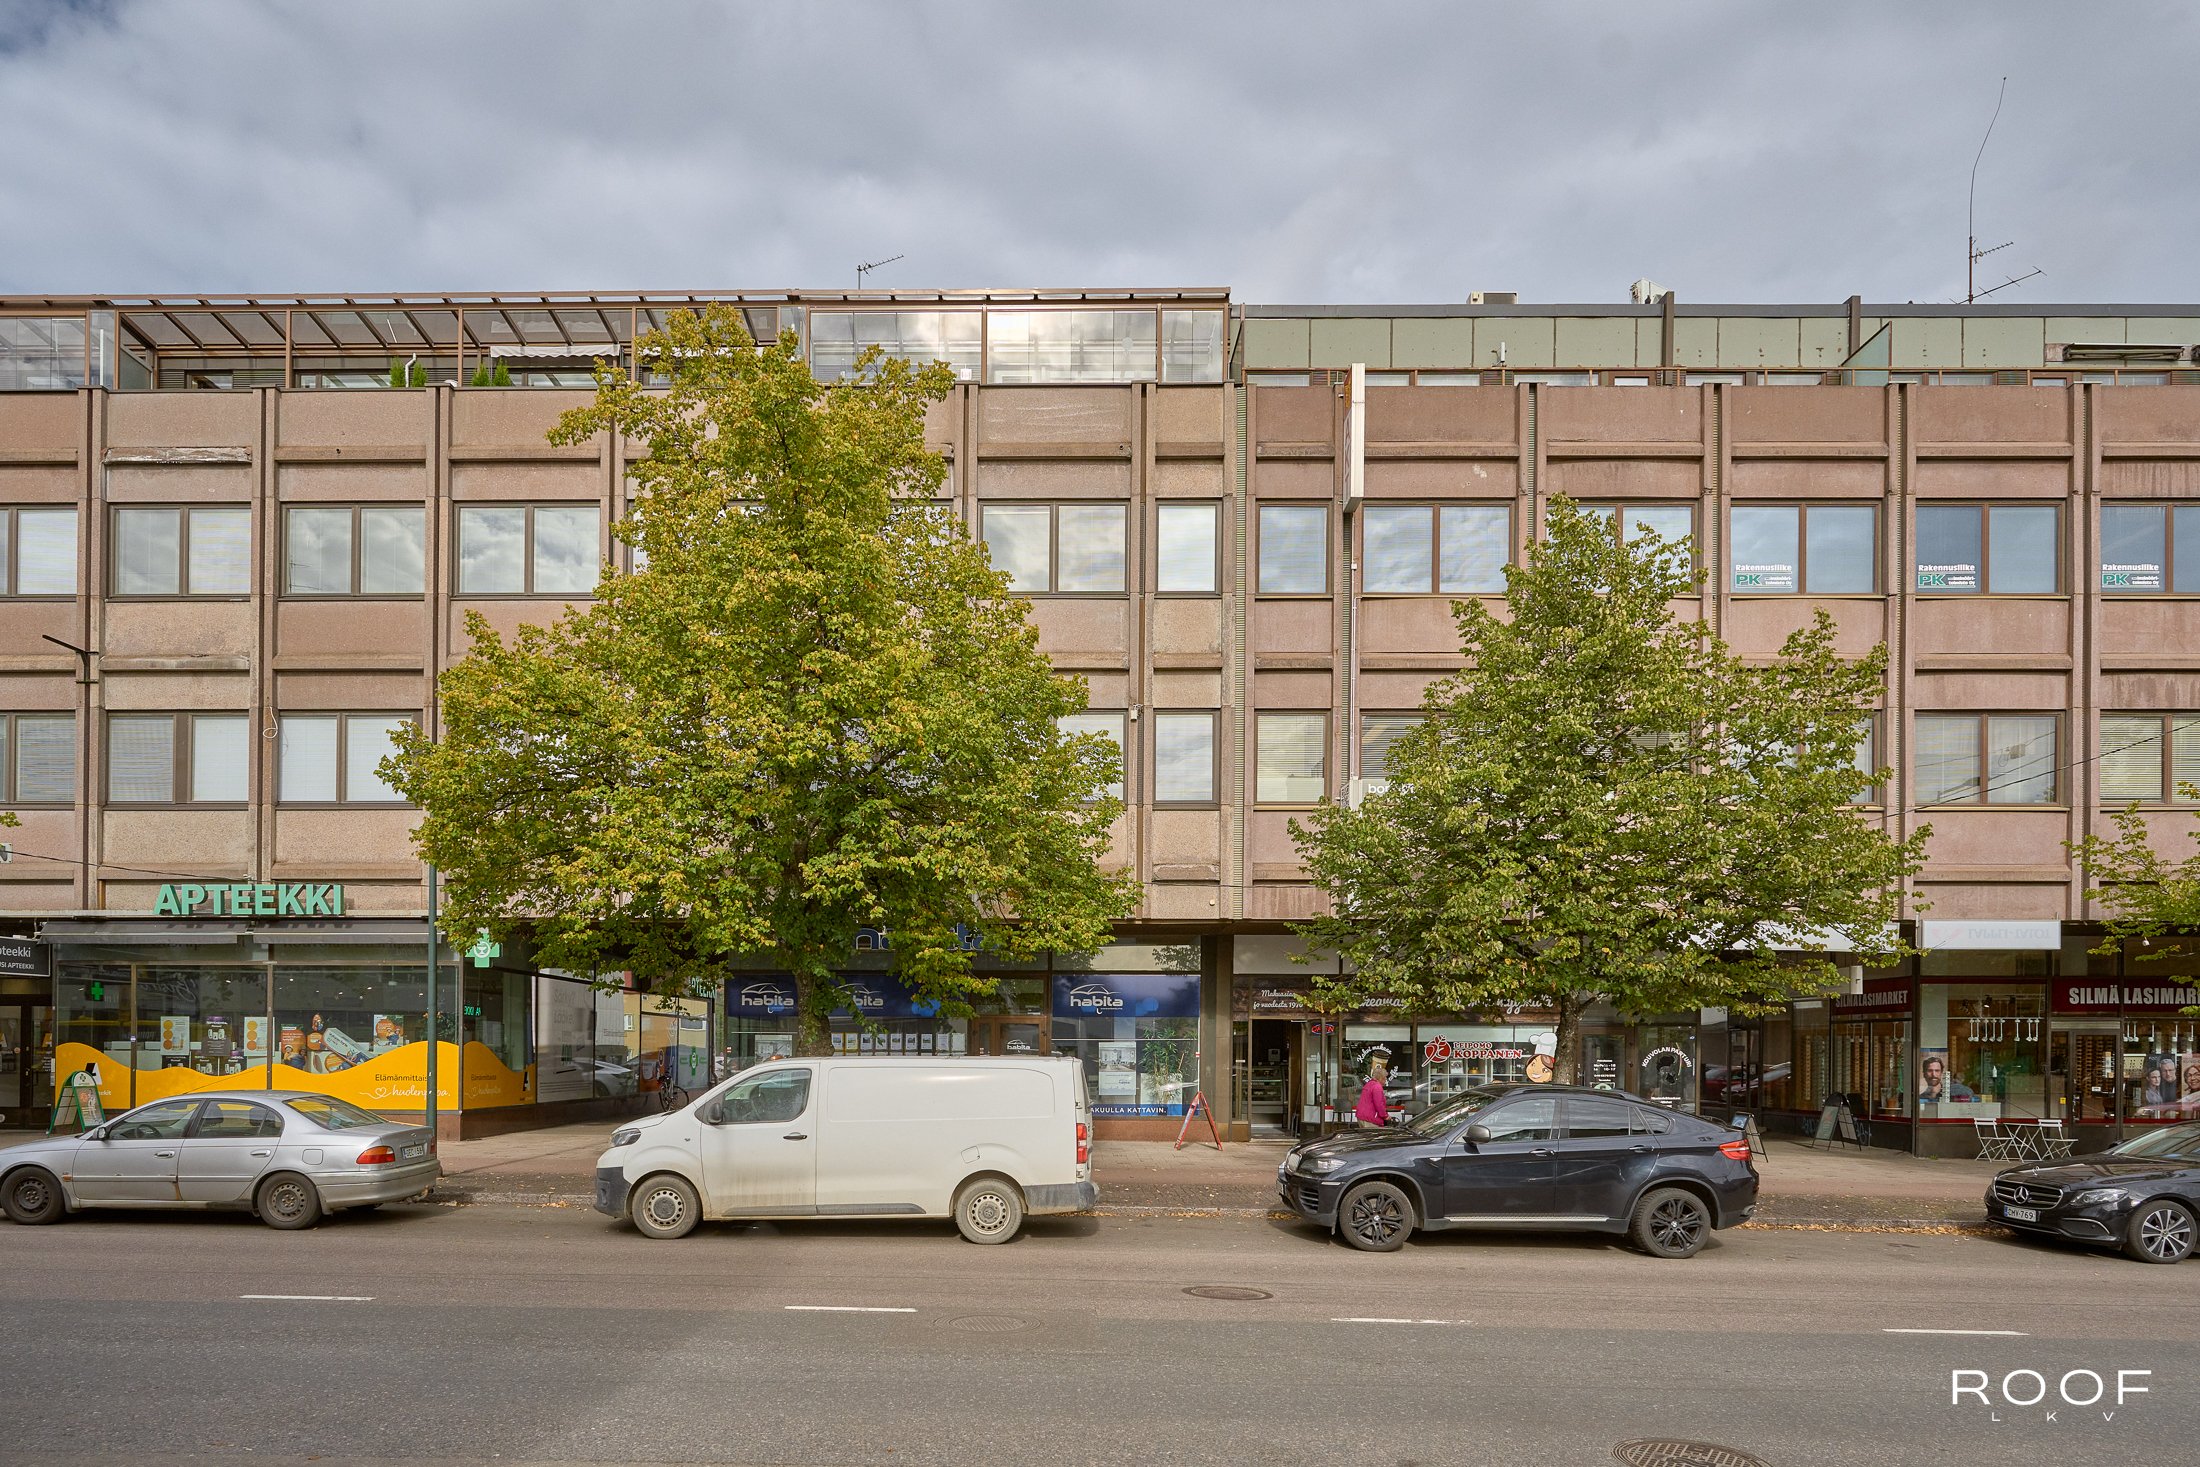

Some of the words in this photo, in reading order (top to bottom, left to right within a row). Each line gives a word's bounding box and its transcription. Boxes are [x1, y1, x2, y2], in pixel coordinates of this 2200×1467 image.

[1735, 573, 1762, 586] PK
[1918, 574, 1946, 585] PK
[2102, 574, 2129, 585] PK
[153, 884, 342, 915] APTEEKKI
[0, 946, 31, 957] teekki
[2069, 984, 2120, 1004] SILMÄ
[741, 995, 794, 1006] habita
[1070, 996, 1123, 1007] habita
[1453, 1049, 1522, 1059] KOPPANEN
[1641, 1046, 1671, 1067] KOUVOLAN
[1671, 1047, 1692, 1067] PARTURI
[375, 1073, 428, 1082] Elämänmittais
